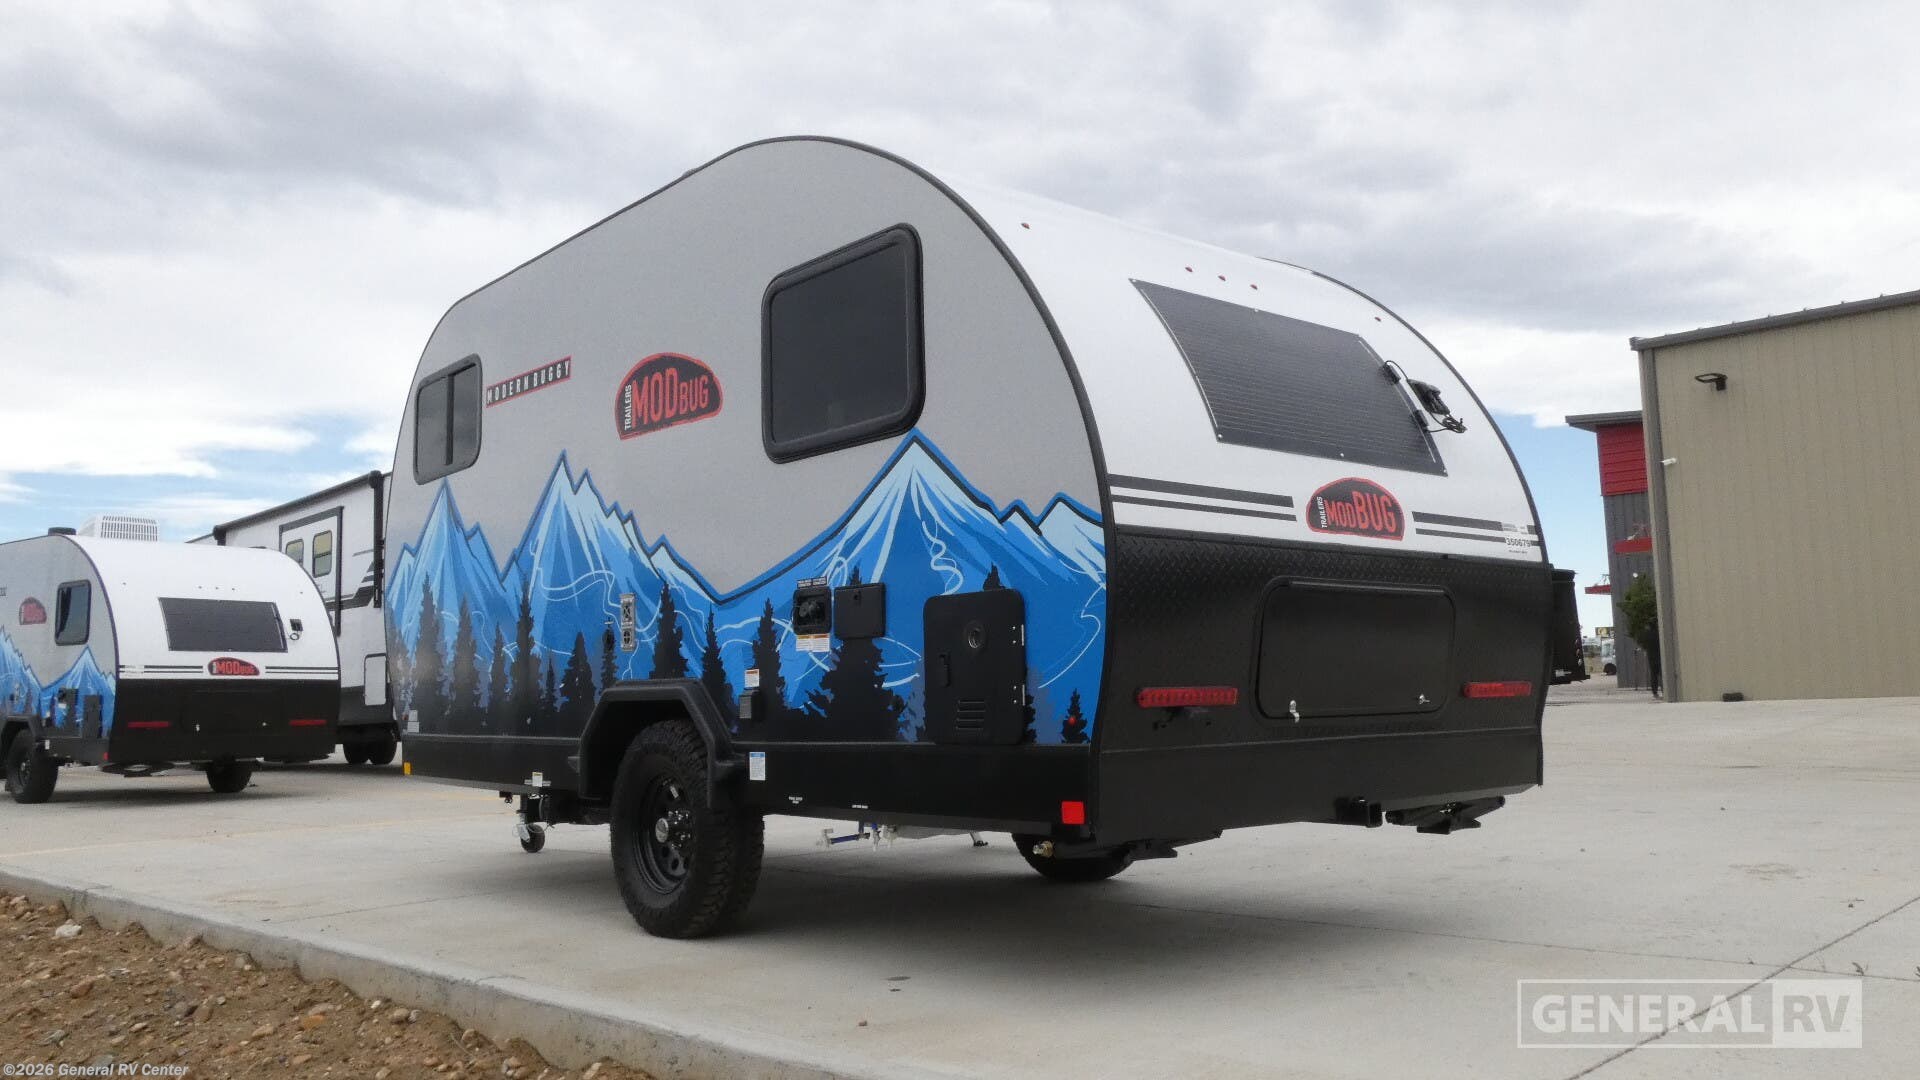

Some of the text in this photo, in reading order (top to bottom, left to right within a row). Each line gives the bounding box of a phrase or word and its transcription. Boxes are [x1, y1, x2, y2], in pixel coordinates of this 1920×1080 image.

[487, 361, 569, 404] MODERN BUGGY
[624, 384, 633, 431] TRAILERS
[1317, 496, 1328, 528] TRAILERS
